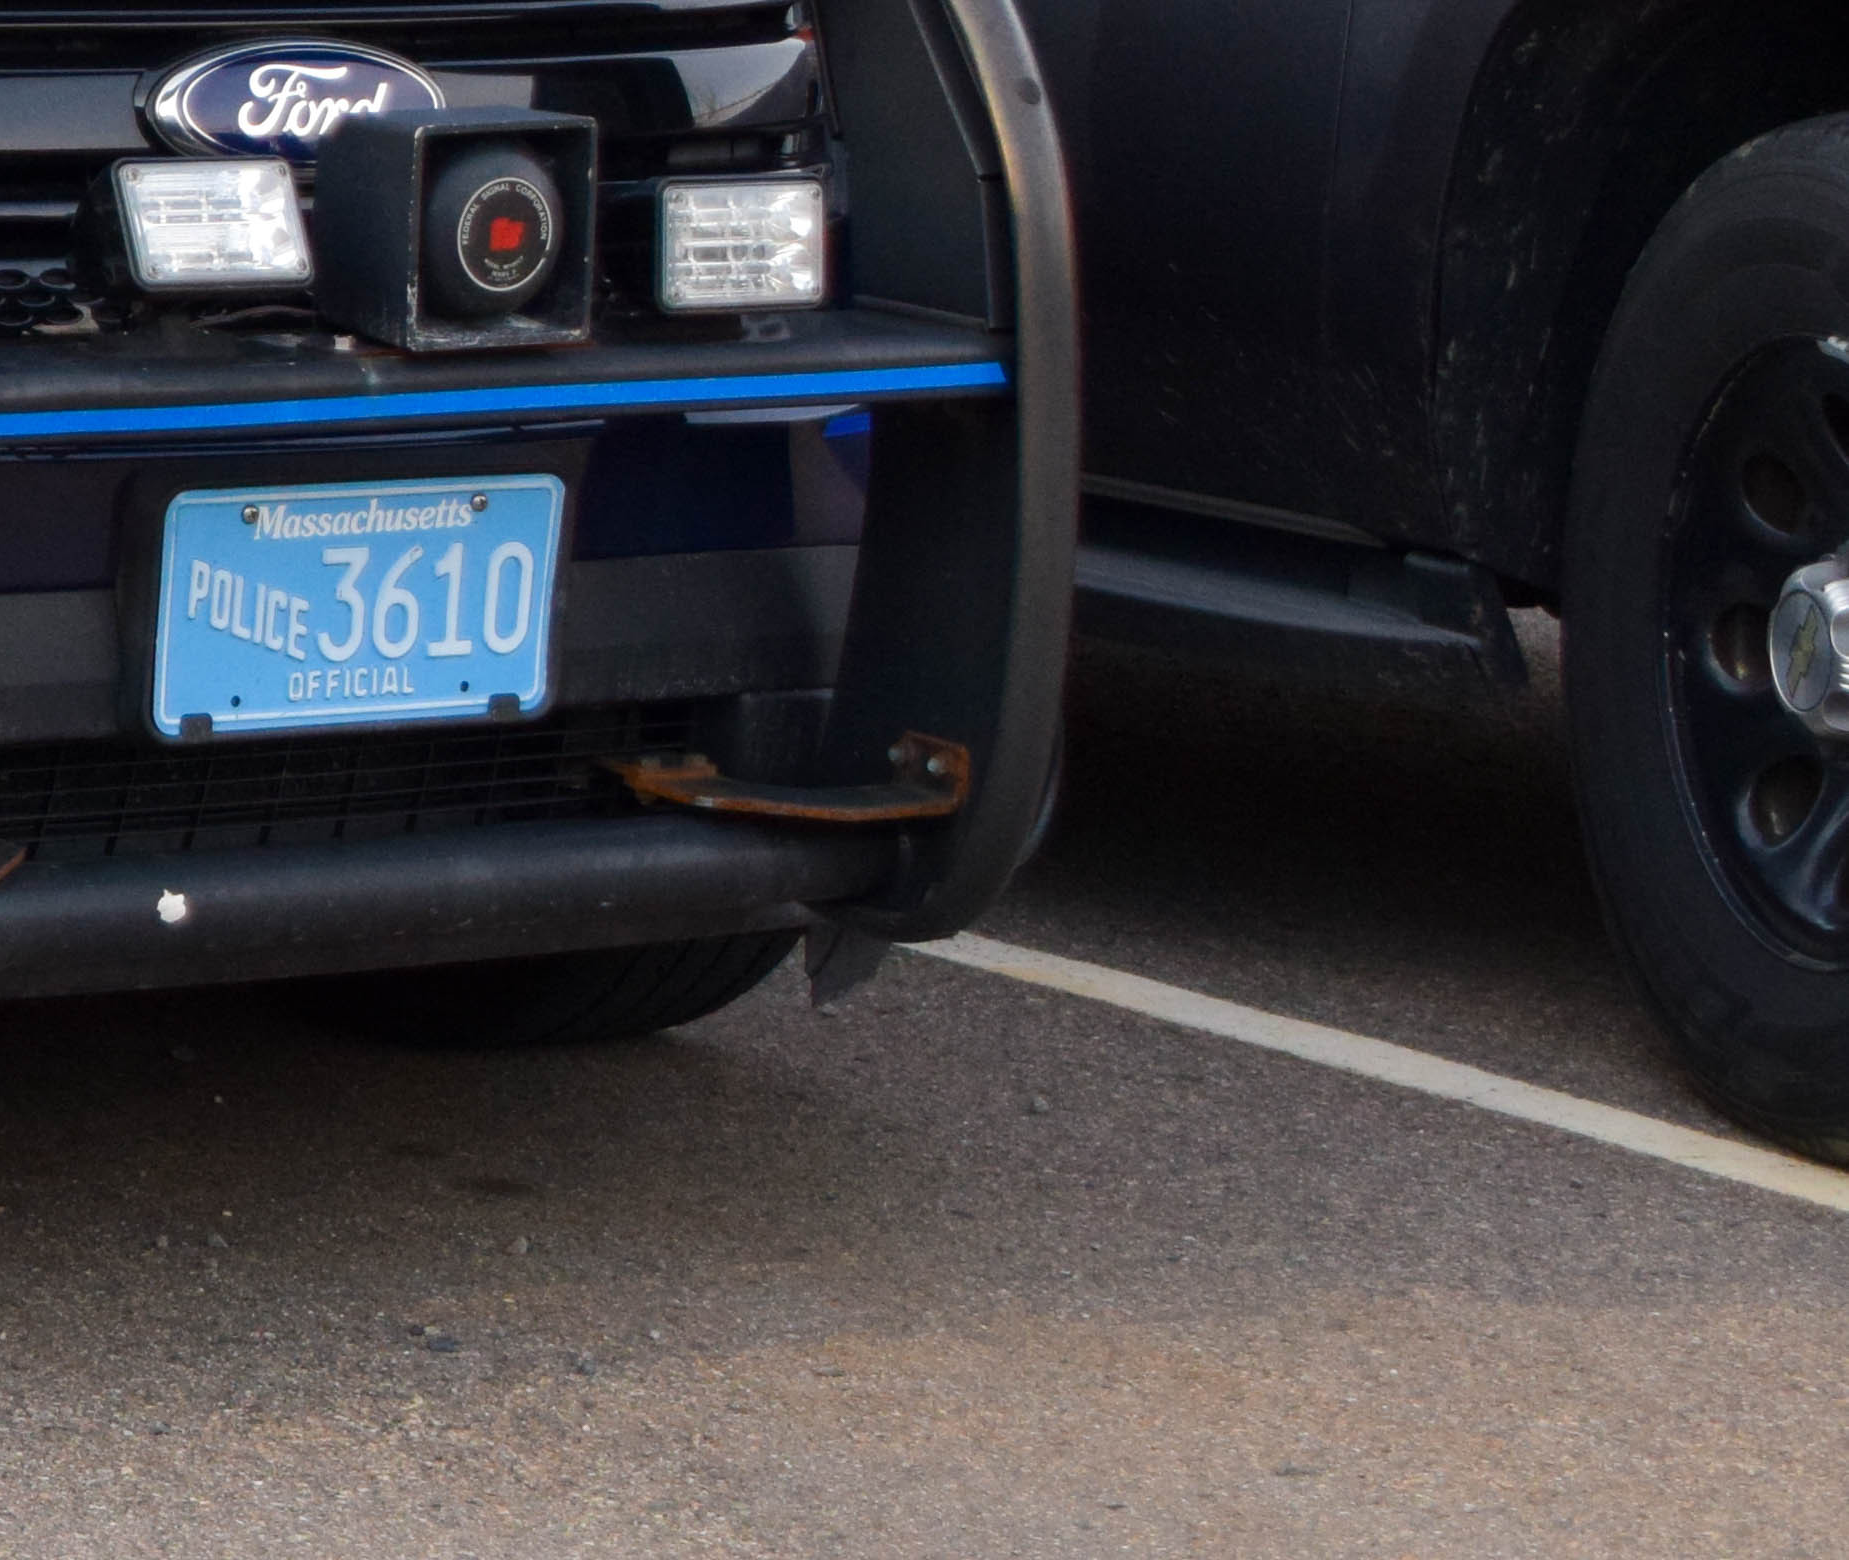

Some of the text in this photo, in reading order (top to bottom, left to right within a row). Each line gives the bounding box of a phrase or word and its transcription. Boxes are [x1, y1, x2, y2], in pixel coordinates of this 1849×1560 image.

[239, 63, 389, 138] Ford
[462, 183, 548, 245] FEDERAL SIGNAL CORPORATION
[254, 499, 473, 540] Massachusetts
[188, 541, 534, 662] POLICE 3610
[288, 666, 416, 702] OFFICIAL
